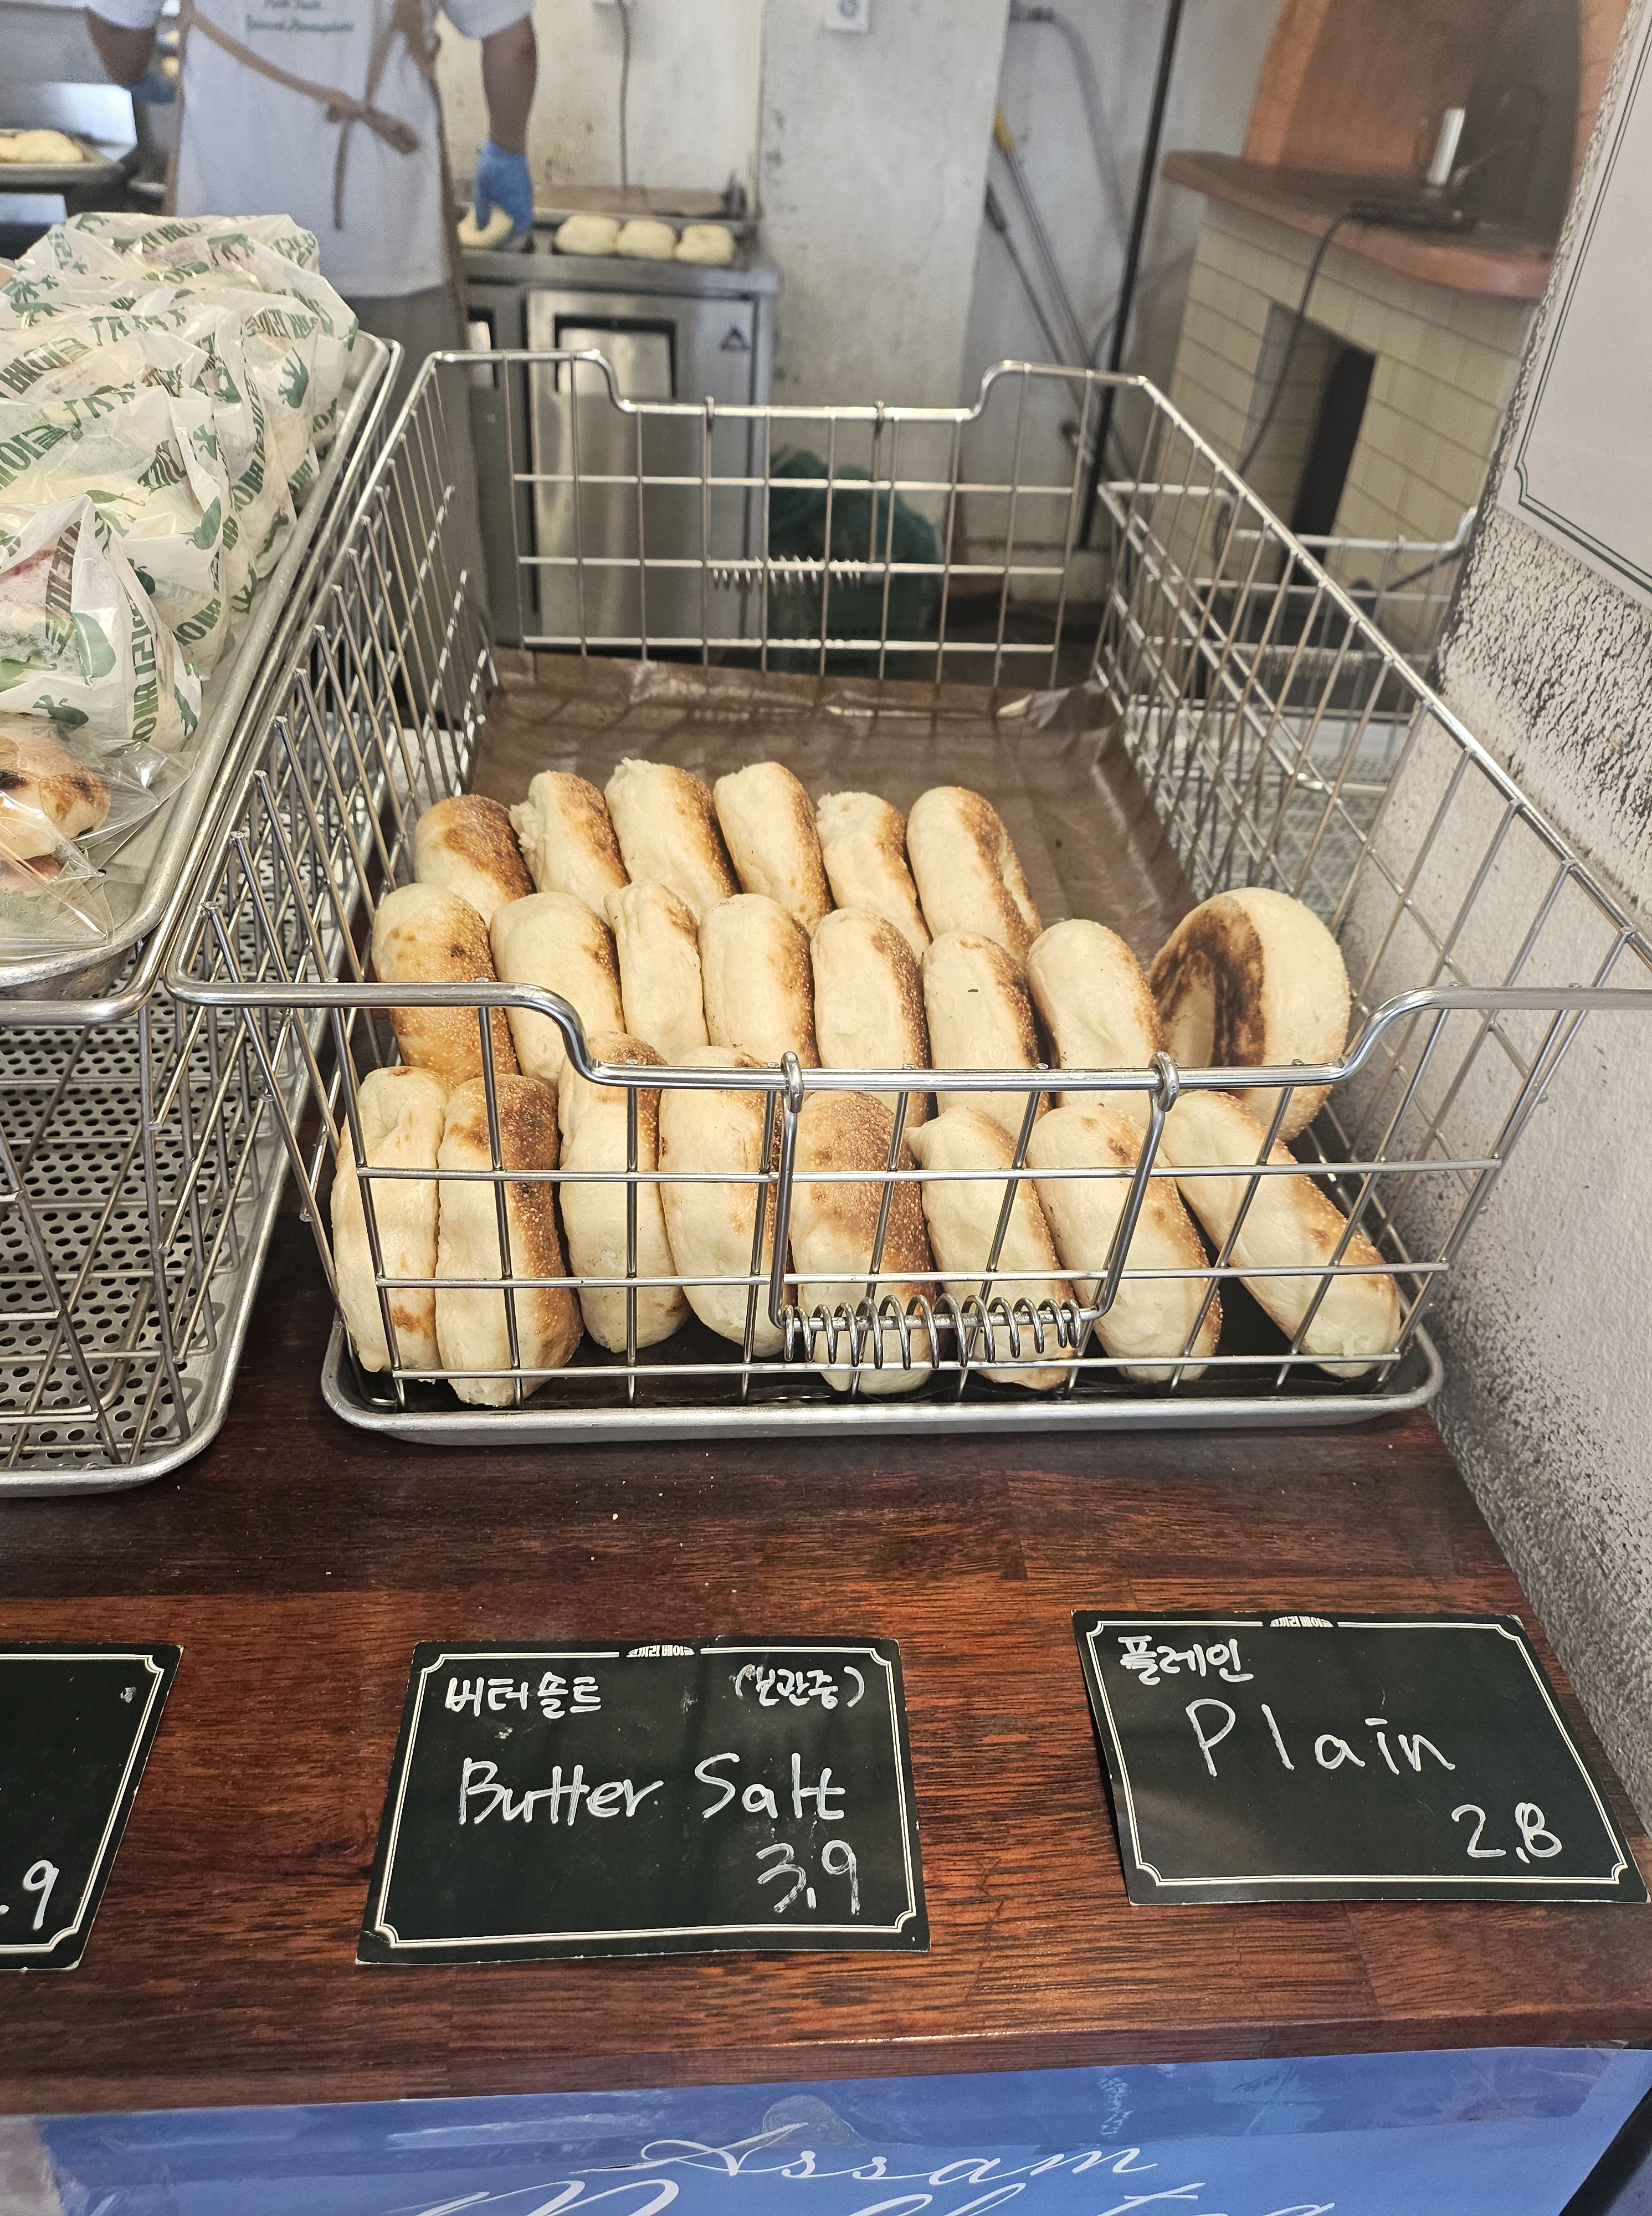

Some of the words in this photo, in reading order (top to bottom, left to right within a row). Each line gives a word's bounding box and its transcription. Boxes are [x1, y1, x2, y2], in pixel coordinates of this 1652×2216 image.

[1117, 1635, 1254, 1685] 플레인
[445, 1671, 602, 1719] 버터솔트
[1185, 1698, 1456, 1777] Plain
[459, 1757, 664, 1826] Butter
[694, 1752, 845, 1820] Salt
[568, 2121, 1159, 2186] Assam
